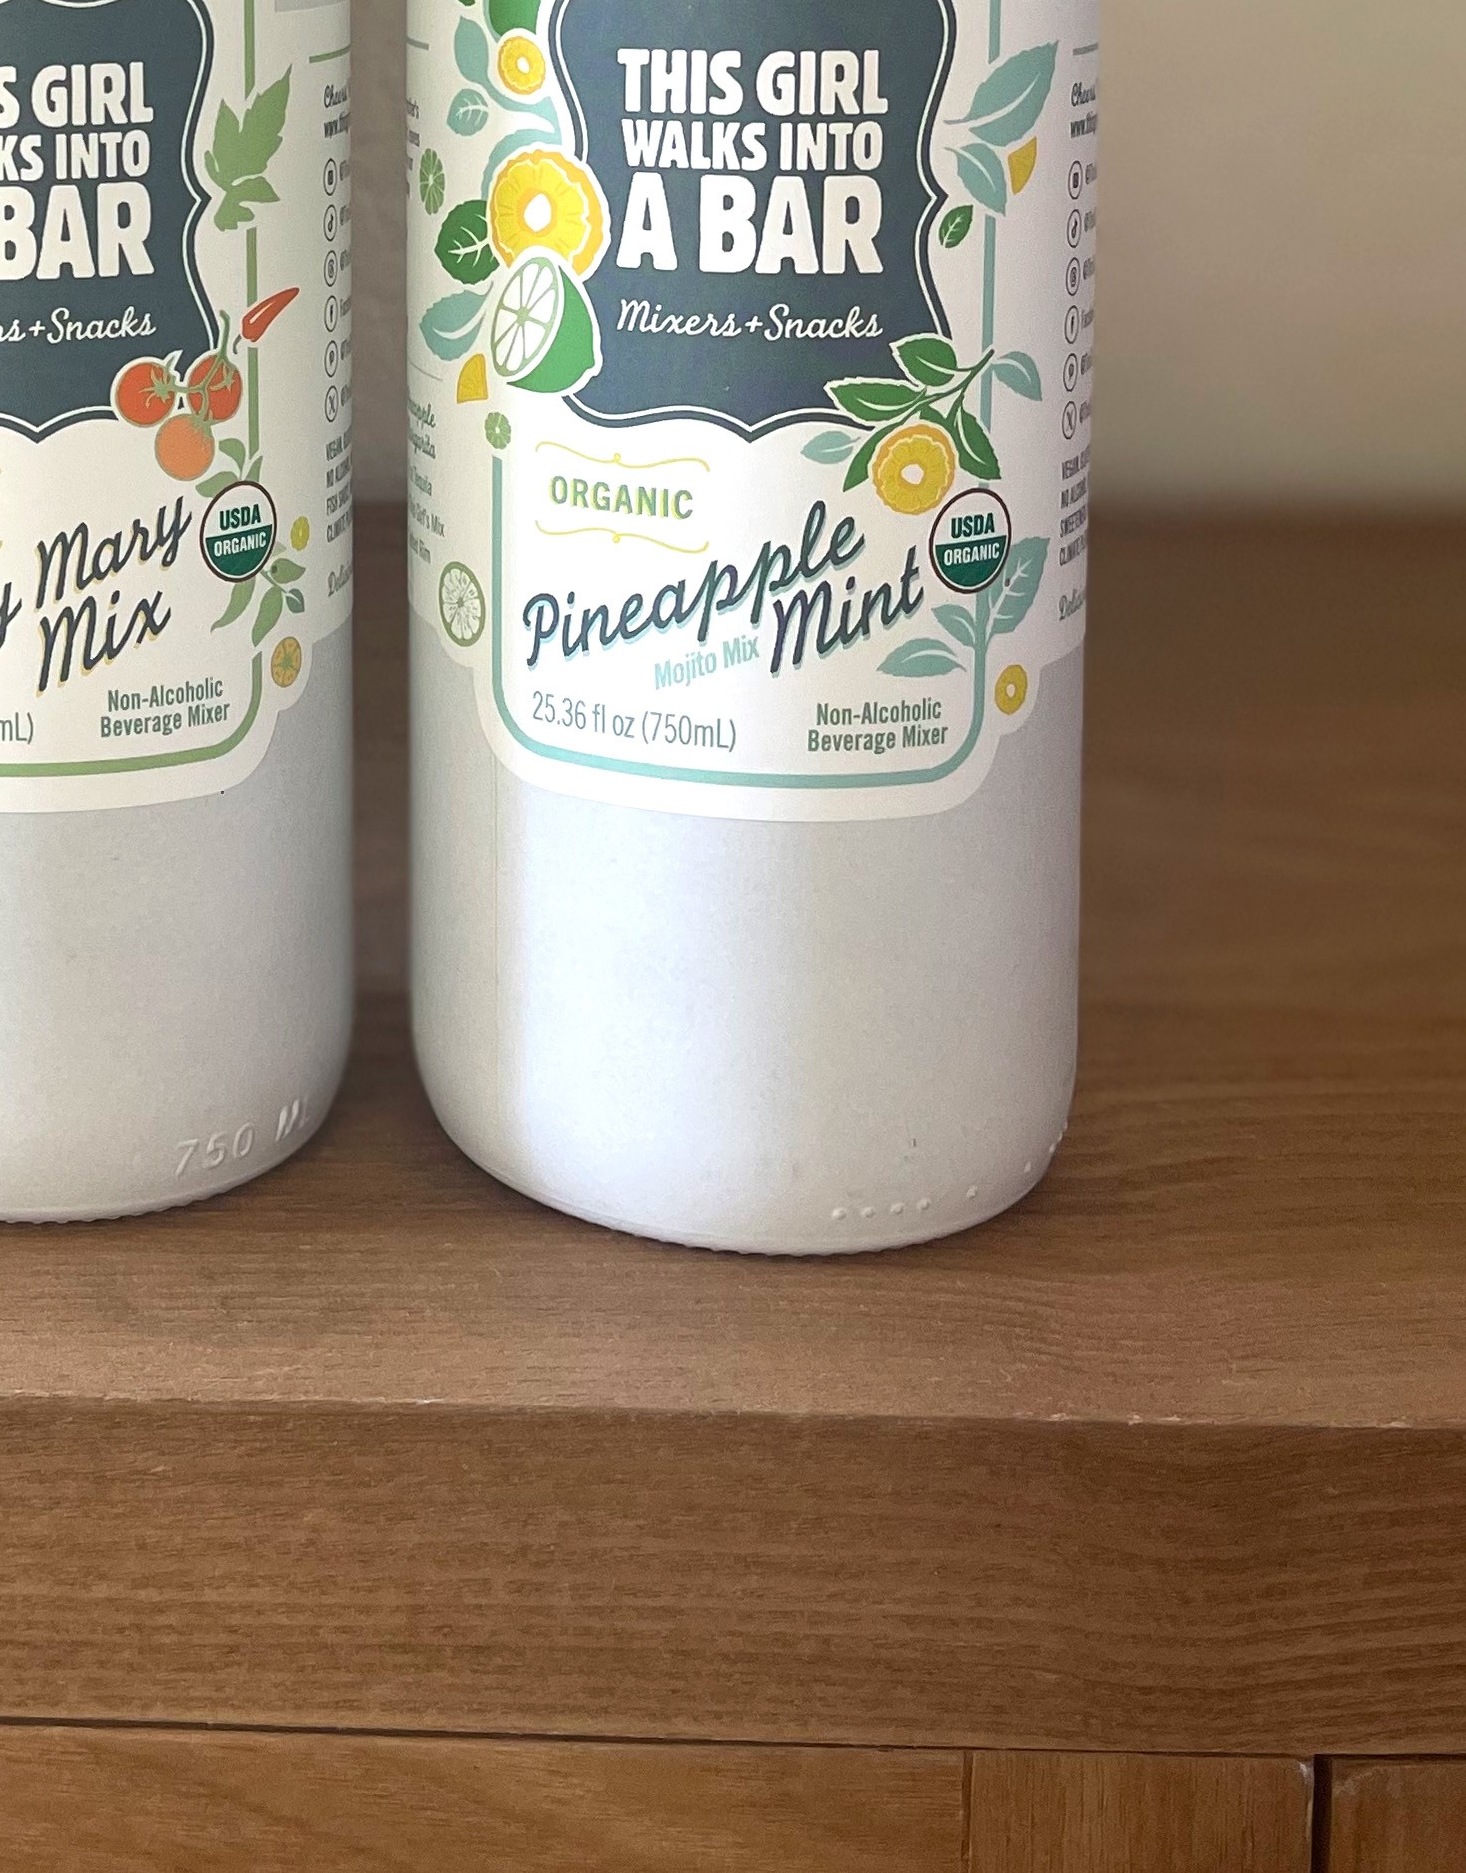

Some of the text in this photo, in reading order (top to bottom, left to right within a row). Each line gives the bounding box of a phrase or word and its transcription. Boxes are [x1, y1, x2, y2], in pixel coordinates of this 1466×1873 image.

[32, 61, 155, 127] GIRL
[616, 47, 889, 116] THIS GIRL
[54, 129, 151, 180] INTO
[620, 118, 884, 171] WALKS INTO
[615, 170, 884, 275] A BAR
[218, 503, 262, 533] USDA
[548, 474, 695, 521] ORGANIC
[213, 529, 269, 559] ORGANIC
[950, 511, 997, 540] USDA
[33, 494, 194, 614] Mary
[942, 540, 1001, 568] ORGANIC
[522, 498, 927, 678] Pineapple Mint
[34, 588, 172, 697] Mix
[653, 634, 761, 692] Mojito Mix
[100, 699, 231, 740] Beverage Mixer
[107, 676, 225, 713] Non-Alcoholic
[815, 697, 943, 728] Non-Alcoholic
[531, 689, 737, 754] 25.36 fl oz (750mL)
[806, 723, 949, 757] Beverage Mixer
[174, 1121, 255, 1177] 750
